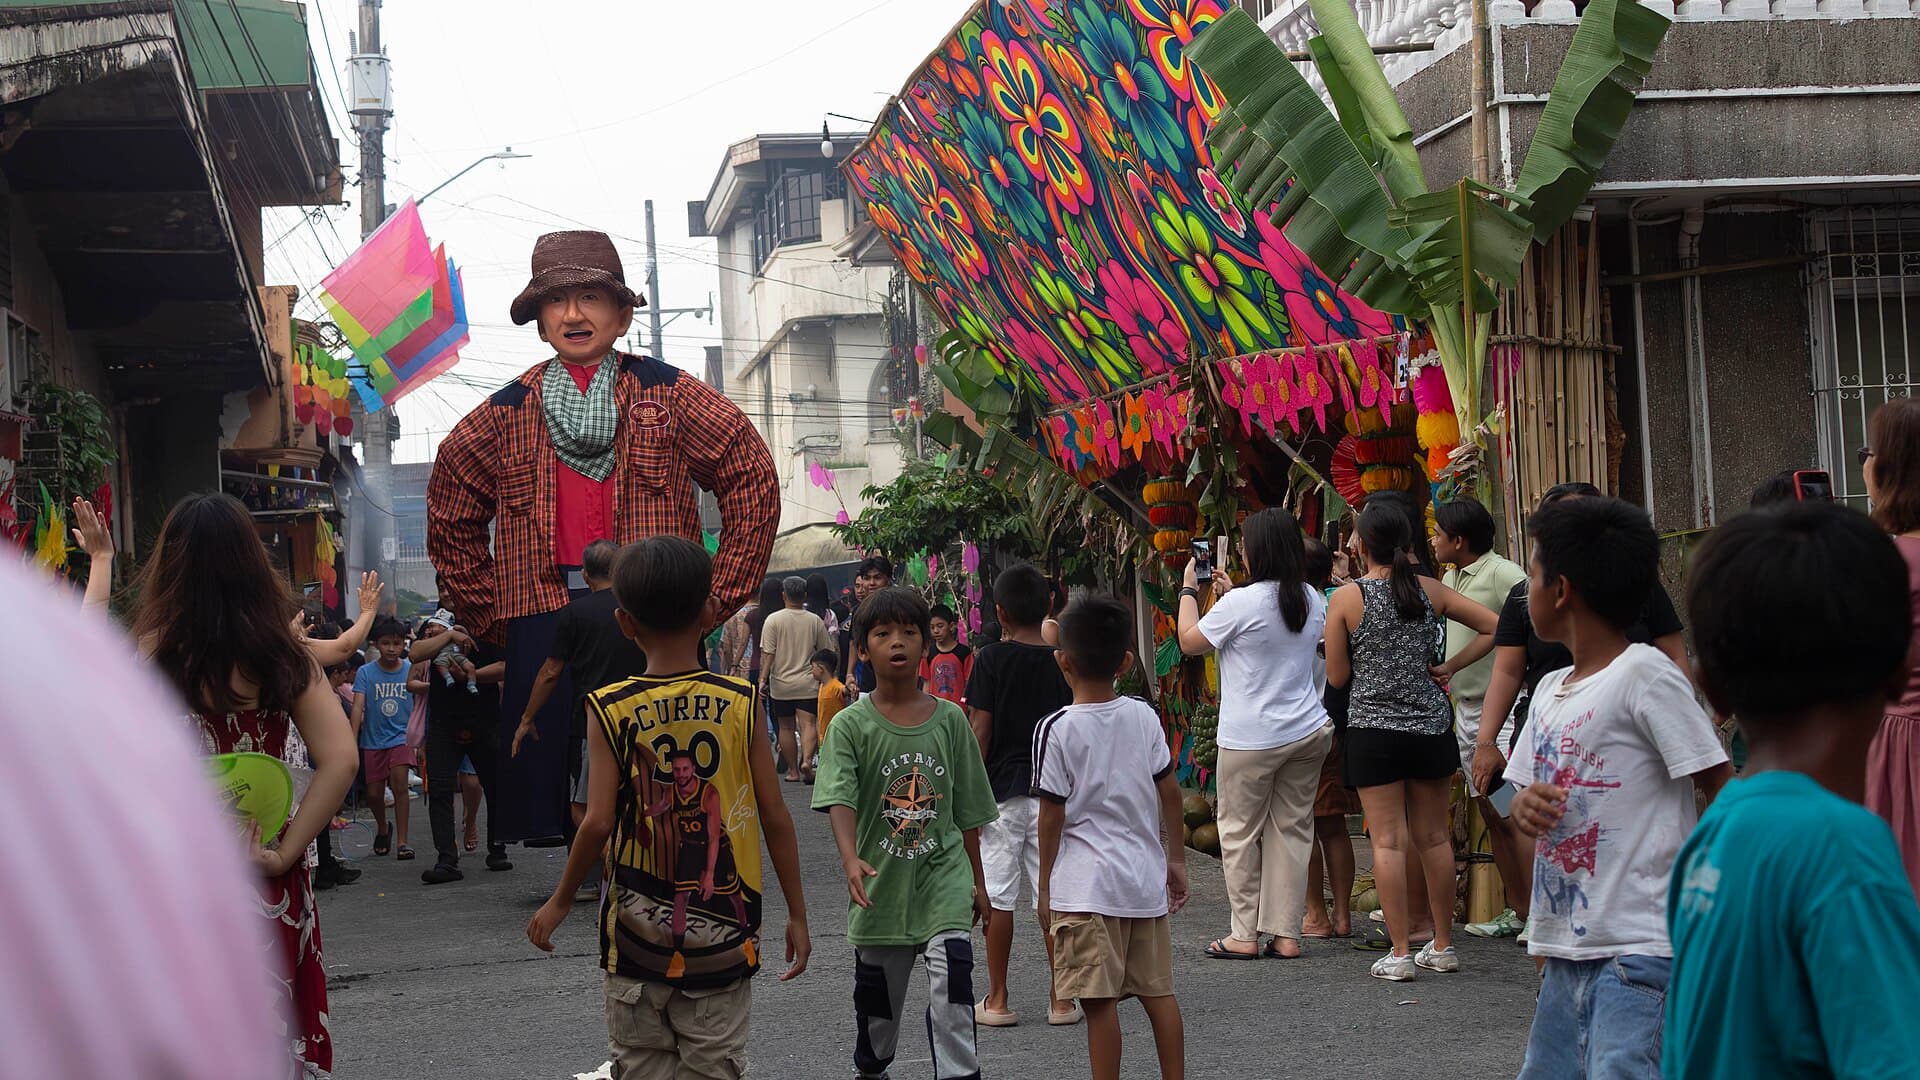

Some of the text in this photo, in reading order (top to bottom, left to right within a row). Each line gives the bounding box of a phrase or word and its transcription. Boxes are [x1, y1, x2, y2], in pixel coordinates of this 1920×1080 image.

[375, 682, 407, 701] NIKE
[634, 694, 731, 732] CURRY
[650, 730, 721, 785] 30
[881, 752, 945, 777] GITANO
